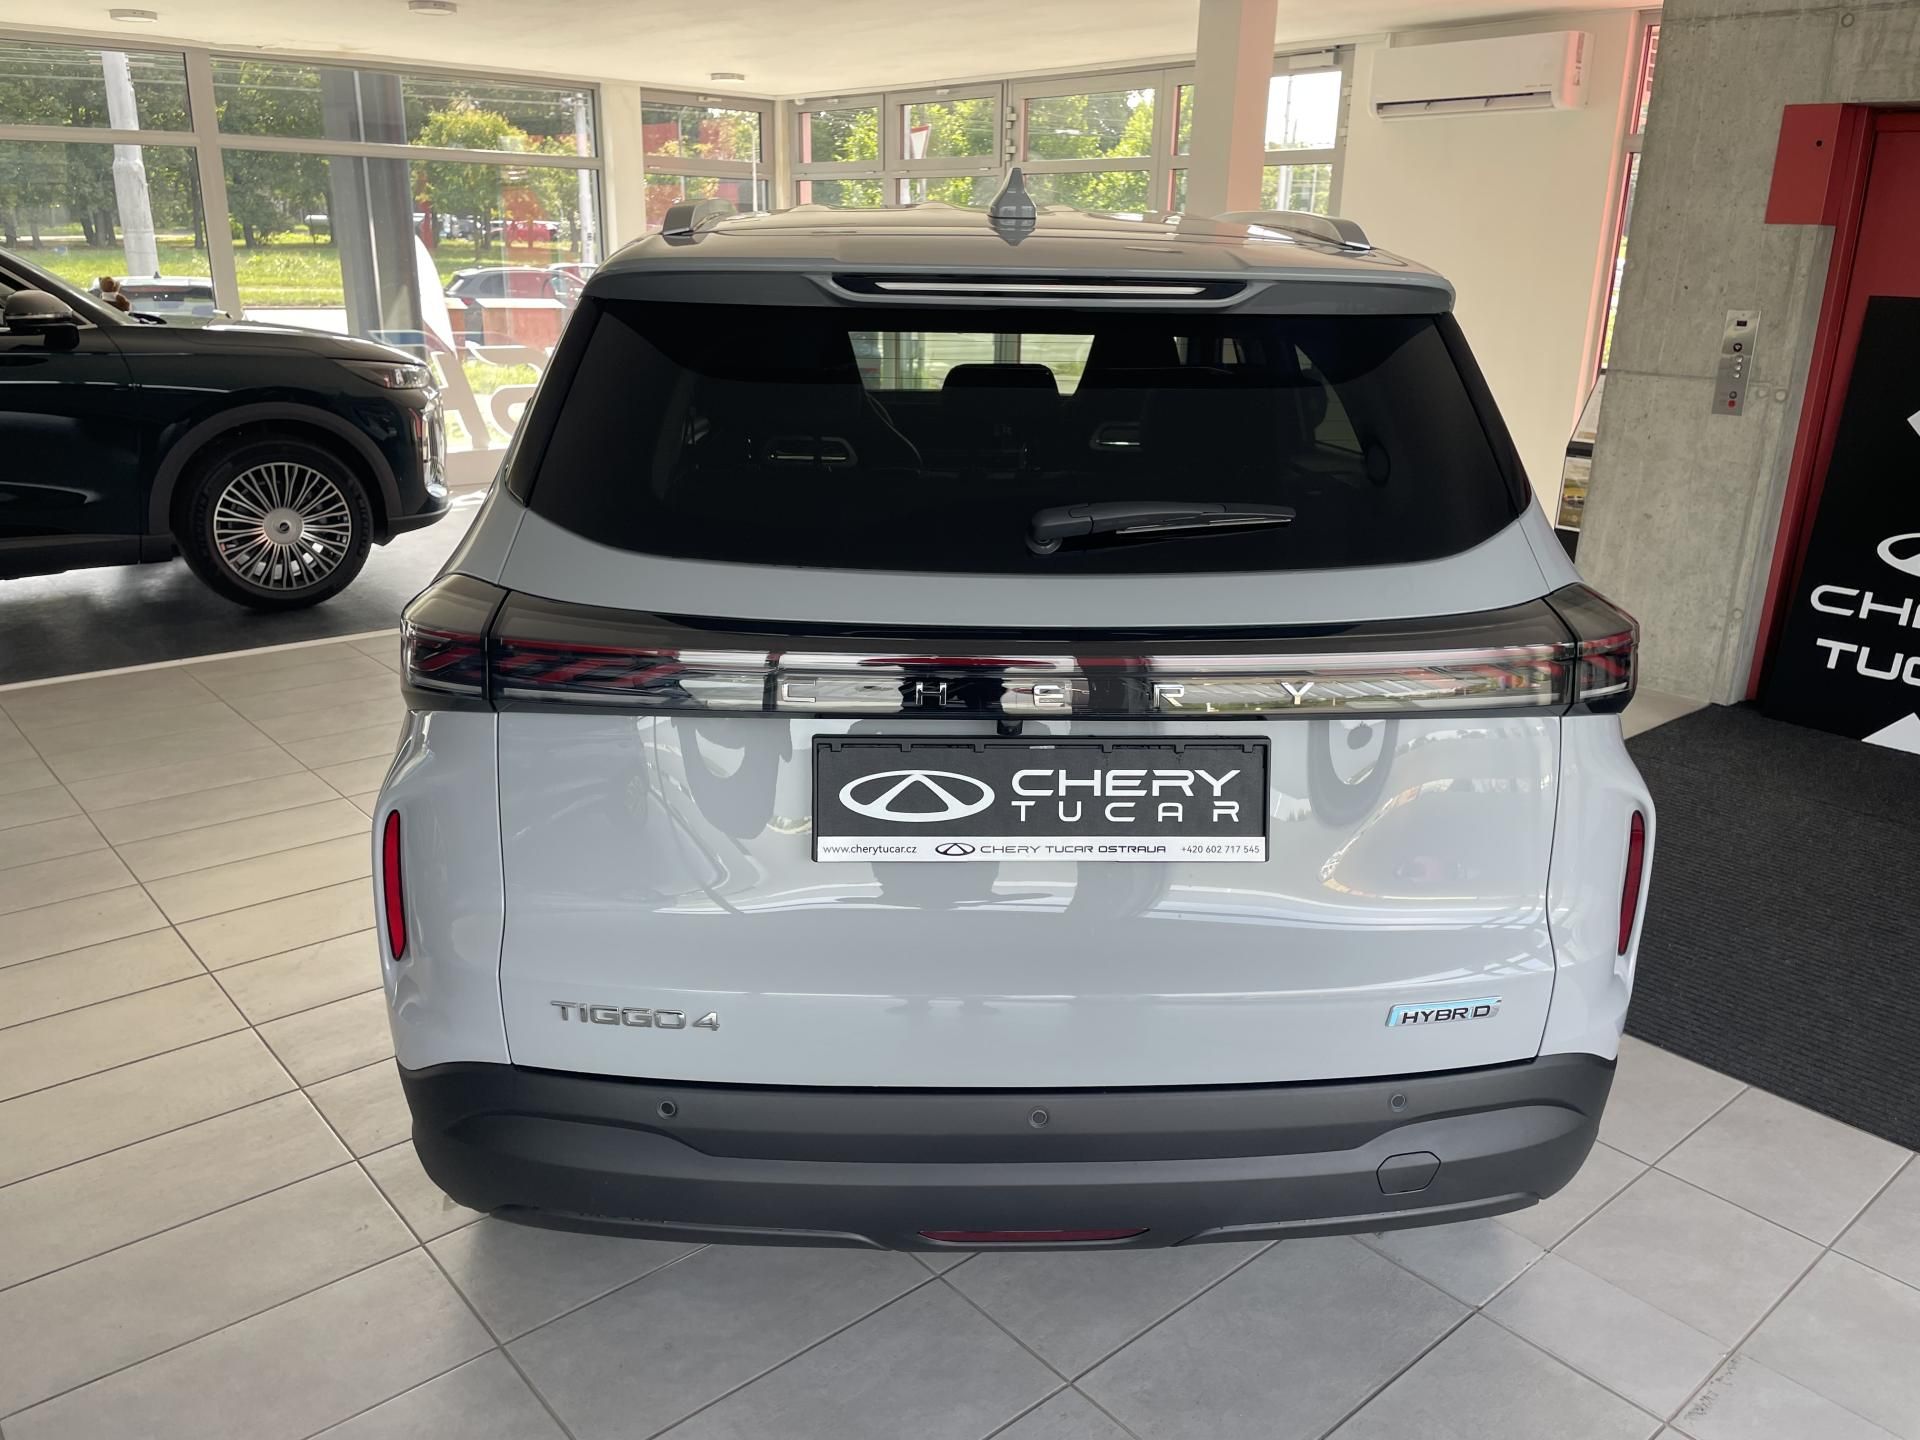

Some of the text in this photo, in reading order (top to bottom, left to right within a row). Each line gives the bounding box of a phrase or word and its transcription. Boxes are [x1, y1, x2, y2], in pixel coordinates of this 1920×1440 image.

[1810, 584, 1920, 629] CH
[781, 680, 1315, 709] CHERY
[1011, 769, 1241, 797] CHERY
[1011, 801, 1240, 823] TUCAR
[823, 844, 918, 856] www.cherytucar.cz
[980, 845, 1041, 854] CHERY
[1045, 845, 1094, 854] TUCAR
[1181, 845, 1260, 855] +420 602 717 545
[550, 1000, 720, 1031] TIGGO 4
[1402, 1005, 1491, 1024] HYBRID
